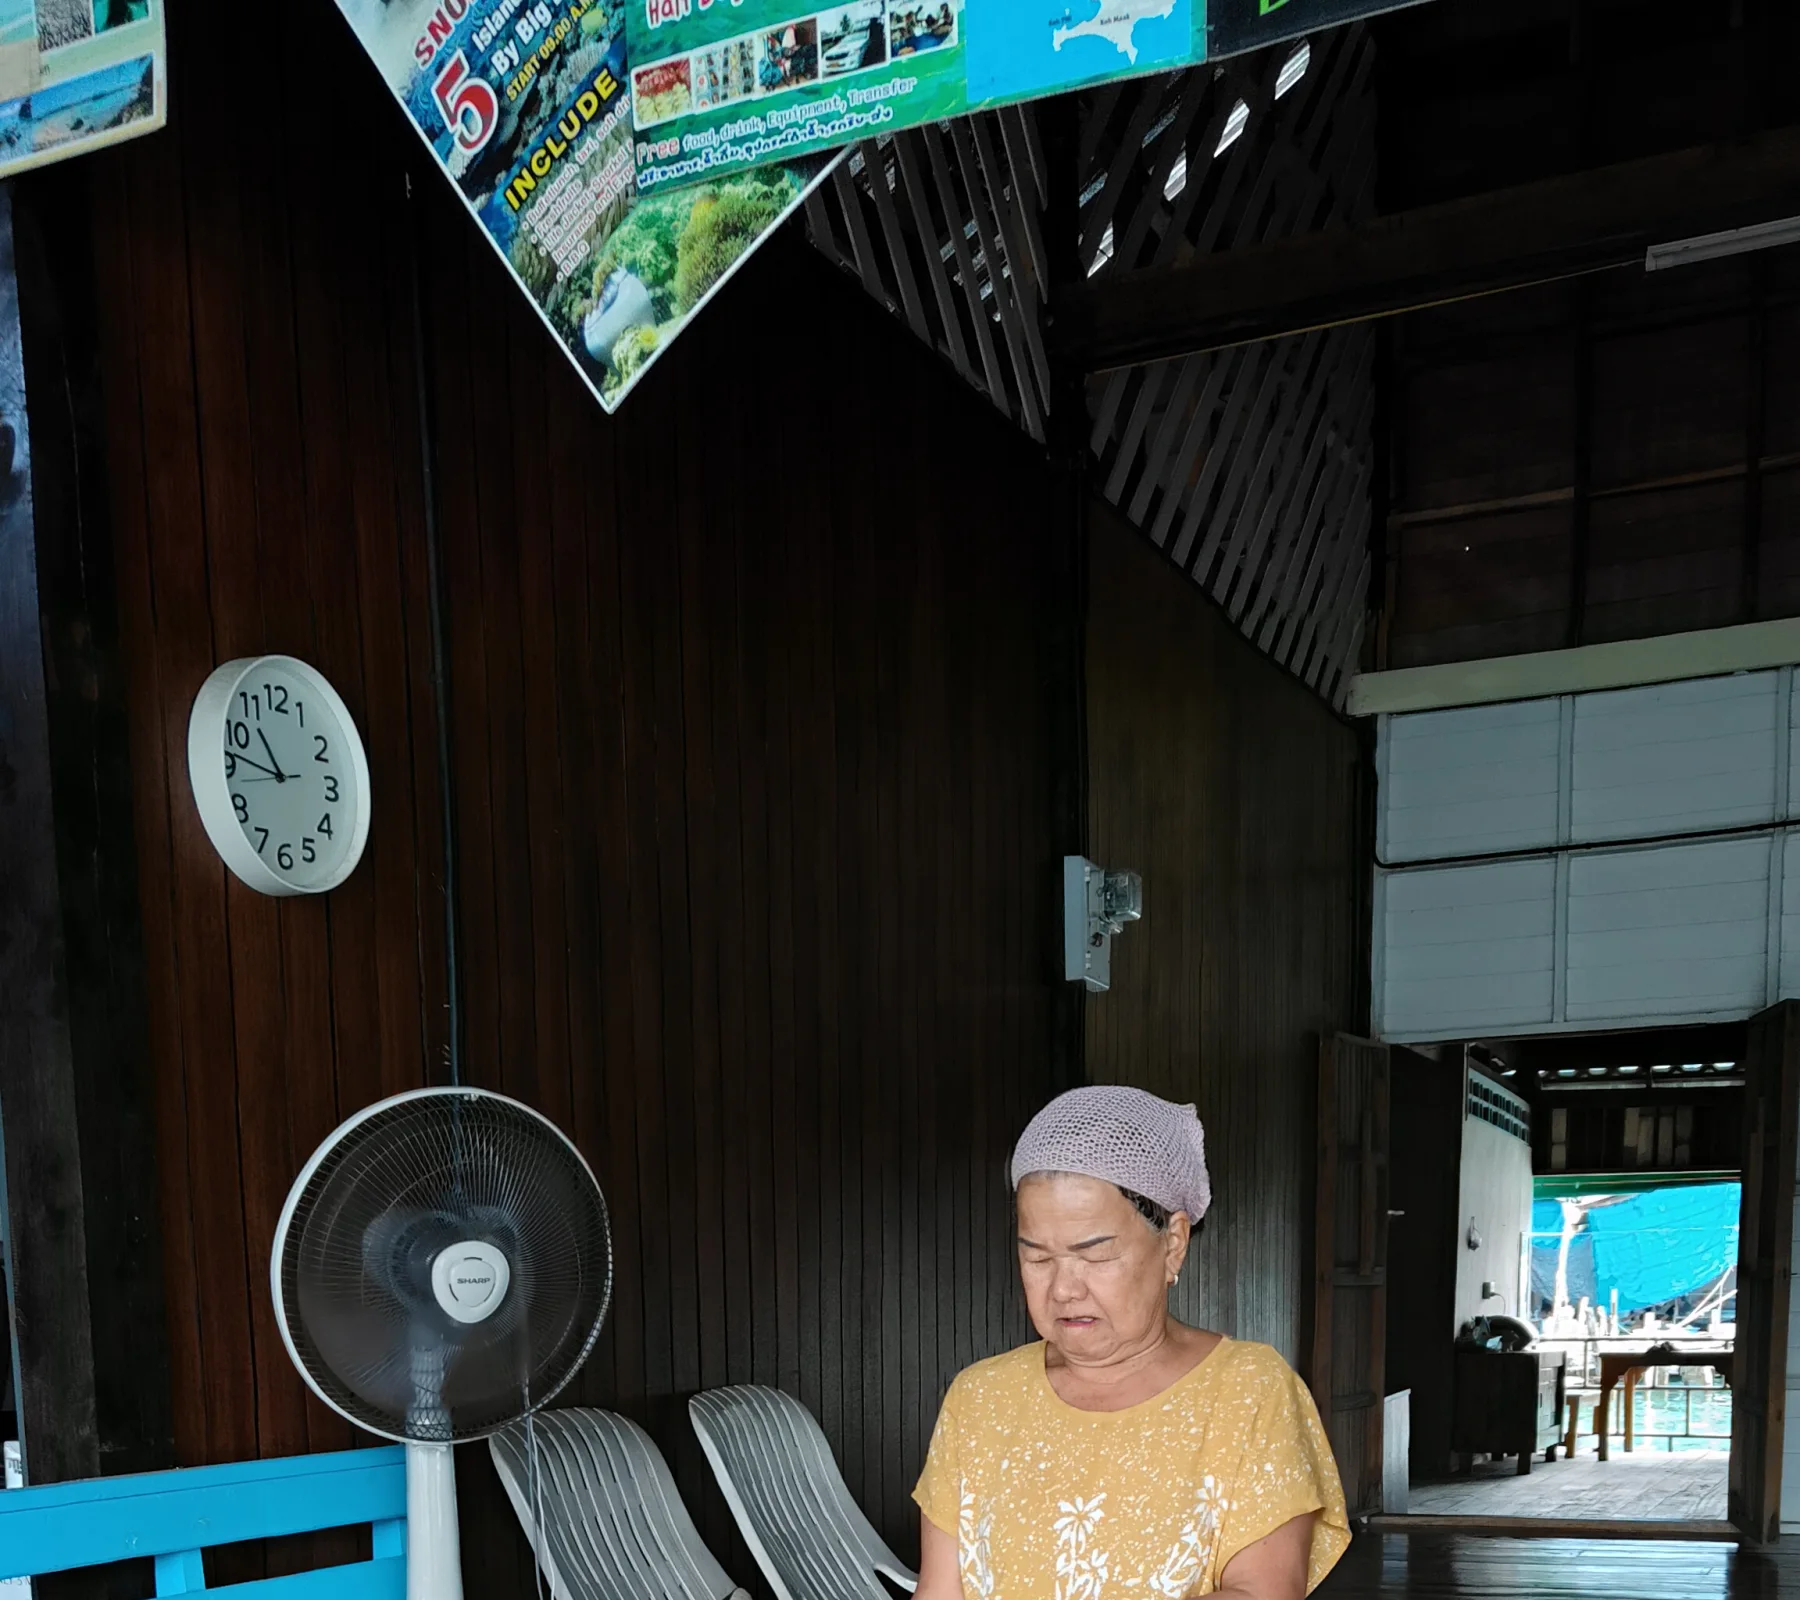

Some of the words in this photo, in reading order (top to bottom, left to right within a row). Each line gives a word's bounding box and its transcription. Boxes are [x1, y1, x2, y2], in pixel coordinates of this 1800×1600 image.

[414, 0, 475, 69] SNO
[472, 0, 522, 53] Islan
[490, 39, 520, 76] By
[515, 1, 552, 45] Big
[506, 54, 541, 101] START
[539, 17, 571, 59] 09.00
[432, 50, 498, 154] 5
[596, 112, 616, 140] soft
[636, 138, 679, 165] Free
[849, 77, 917, 107] Transfer
[504, 69, 618, 211] INCLUDE
[543, 226, 564, 254] Life
[590, 148, 629, 192] Snorkel
[552, 210, 597, 265] Insurance
[594, 190, 614, 215] and
[240, 691, 260, 721] 11
[263, 684, 289, 714] 12
[296, 702, 304, 728] 1
[226, 719, 250, 749] 10
[314, 735, 329, 763] 2
[224, 750, 237, 779] 9
[323, 776, 339, 802] 3
[231, 793, 249, 823] 8
[254, 827, 269, 853] 7
[317, 813, 333, 840] 4
[277, 844, 294, 870] 6
[302, 838, 315, 863] 5
[456, 1277, 491, 1285] SHARP
